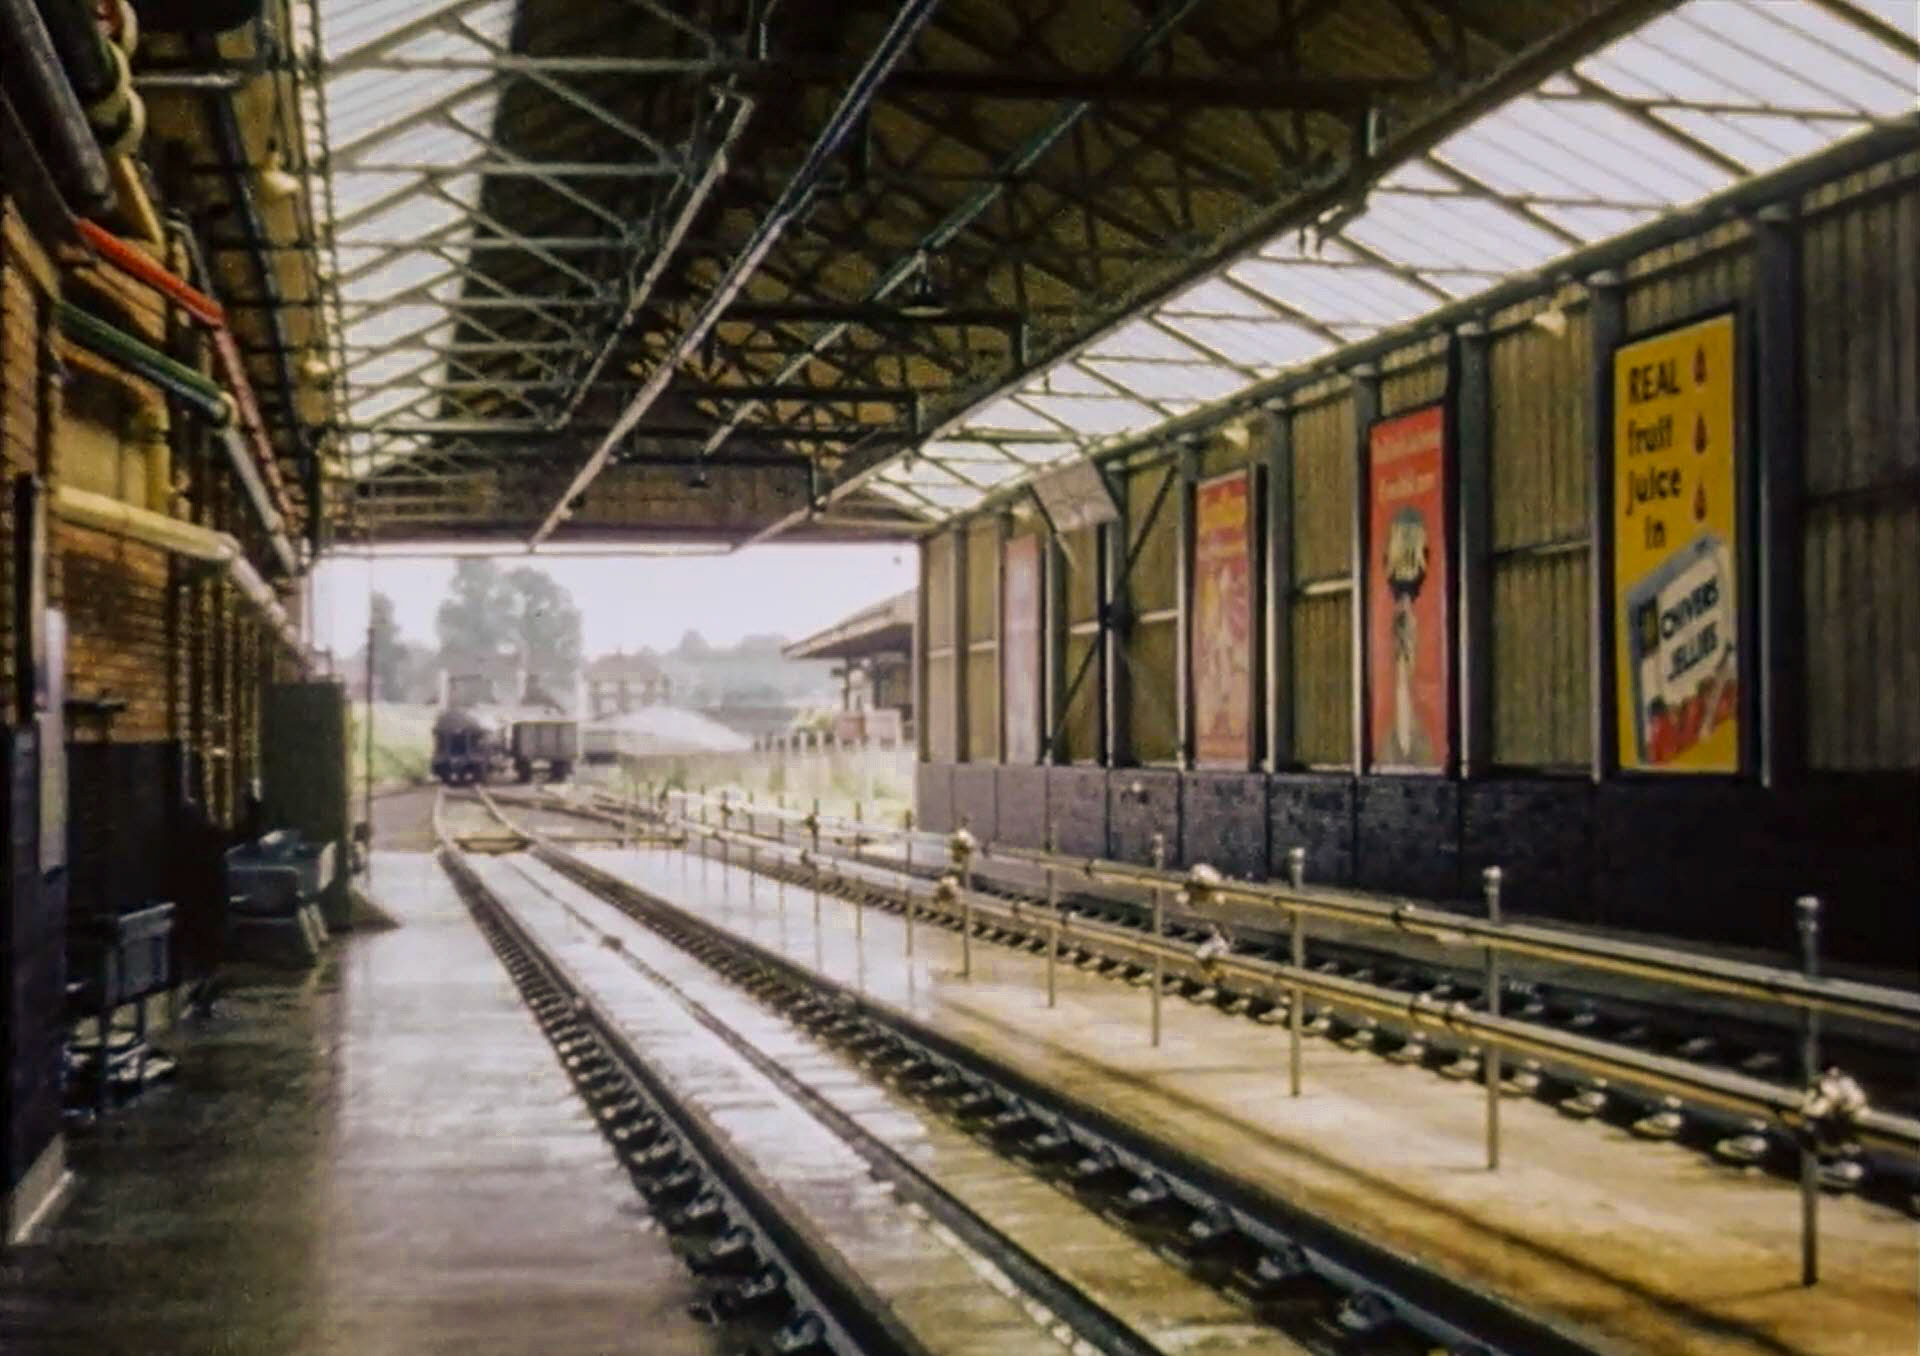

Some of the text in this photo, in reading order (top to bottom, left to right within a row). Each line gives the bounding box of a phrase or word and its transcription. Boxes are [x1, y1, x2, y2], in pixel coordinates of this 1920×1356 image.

[1629, 358, 1681, 404] REAL
[1628, 414, 1672, 457] fruit
[1625, 467, 1681, 516] juice
